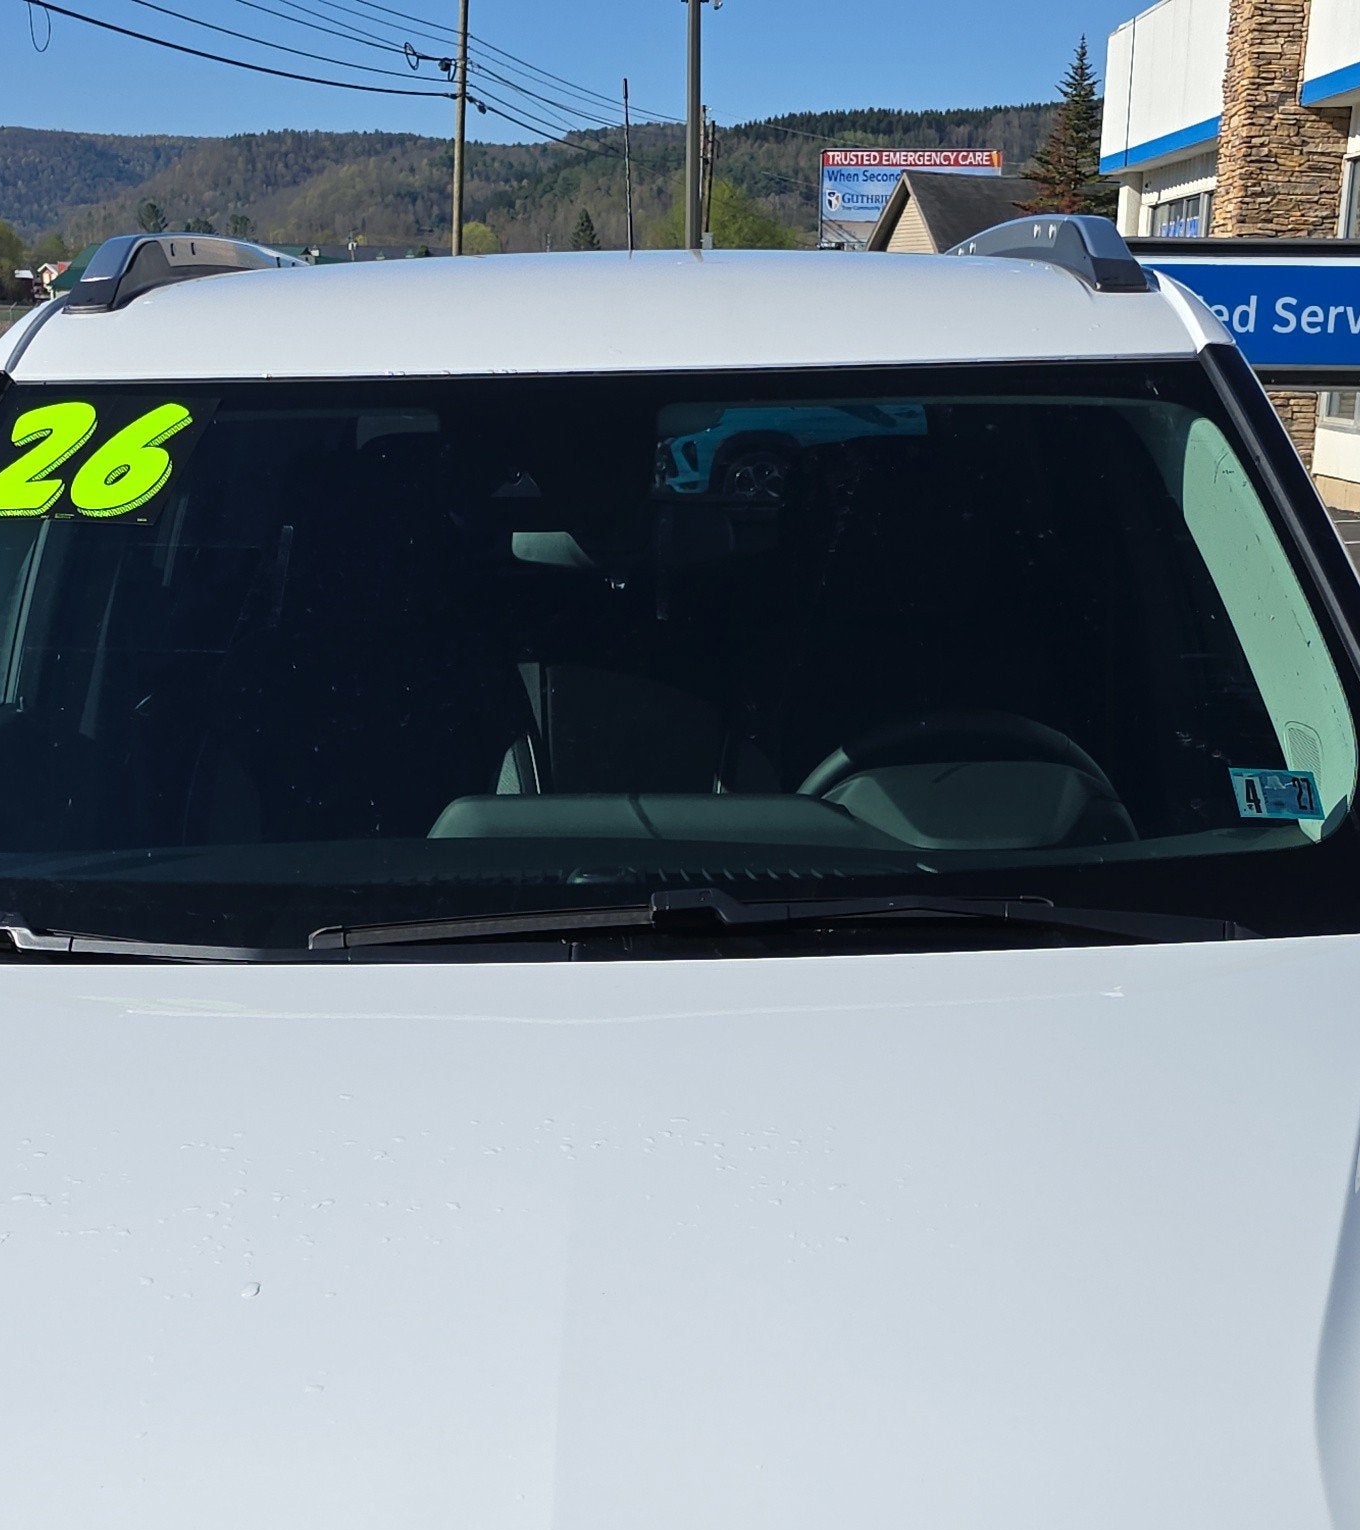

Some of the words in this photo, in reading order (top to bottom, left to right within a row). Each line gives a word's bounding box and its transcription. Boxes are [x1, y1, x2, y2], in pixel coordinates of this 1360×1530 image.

[827, 151, 879, 165] TRUSTED
[882, 151, 956, 165] EMERGENCY
[958, 151, 991, 165] CARE
[827, 169, 859, 182] When
[1197, 295, 1257, 333] ed
[1245, 779, 1263, 813] 4
[1291, 777, 1315, 810] 27
